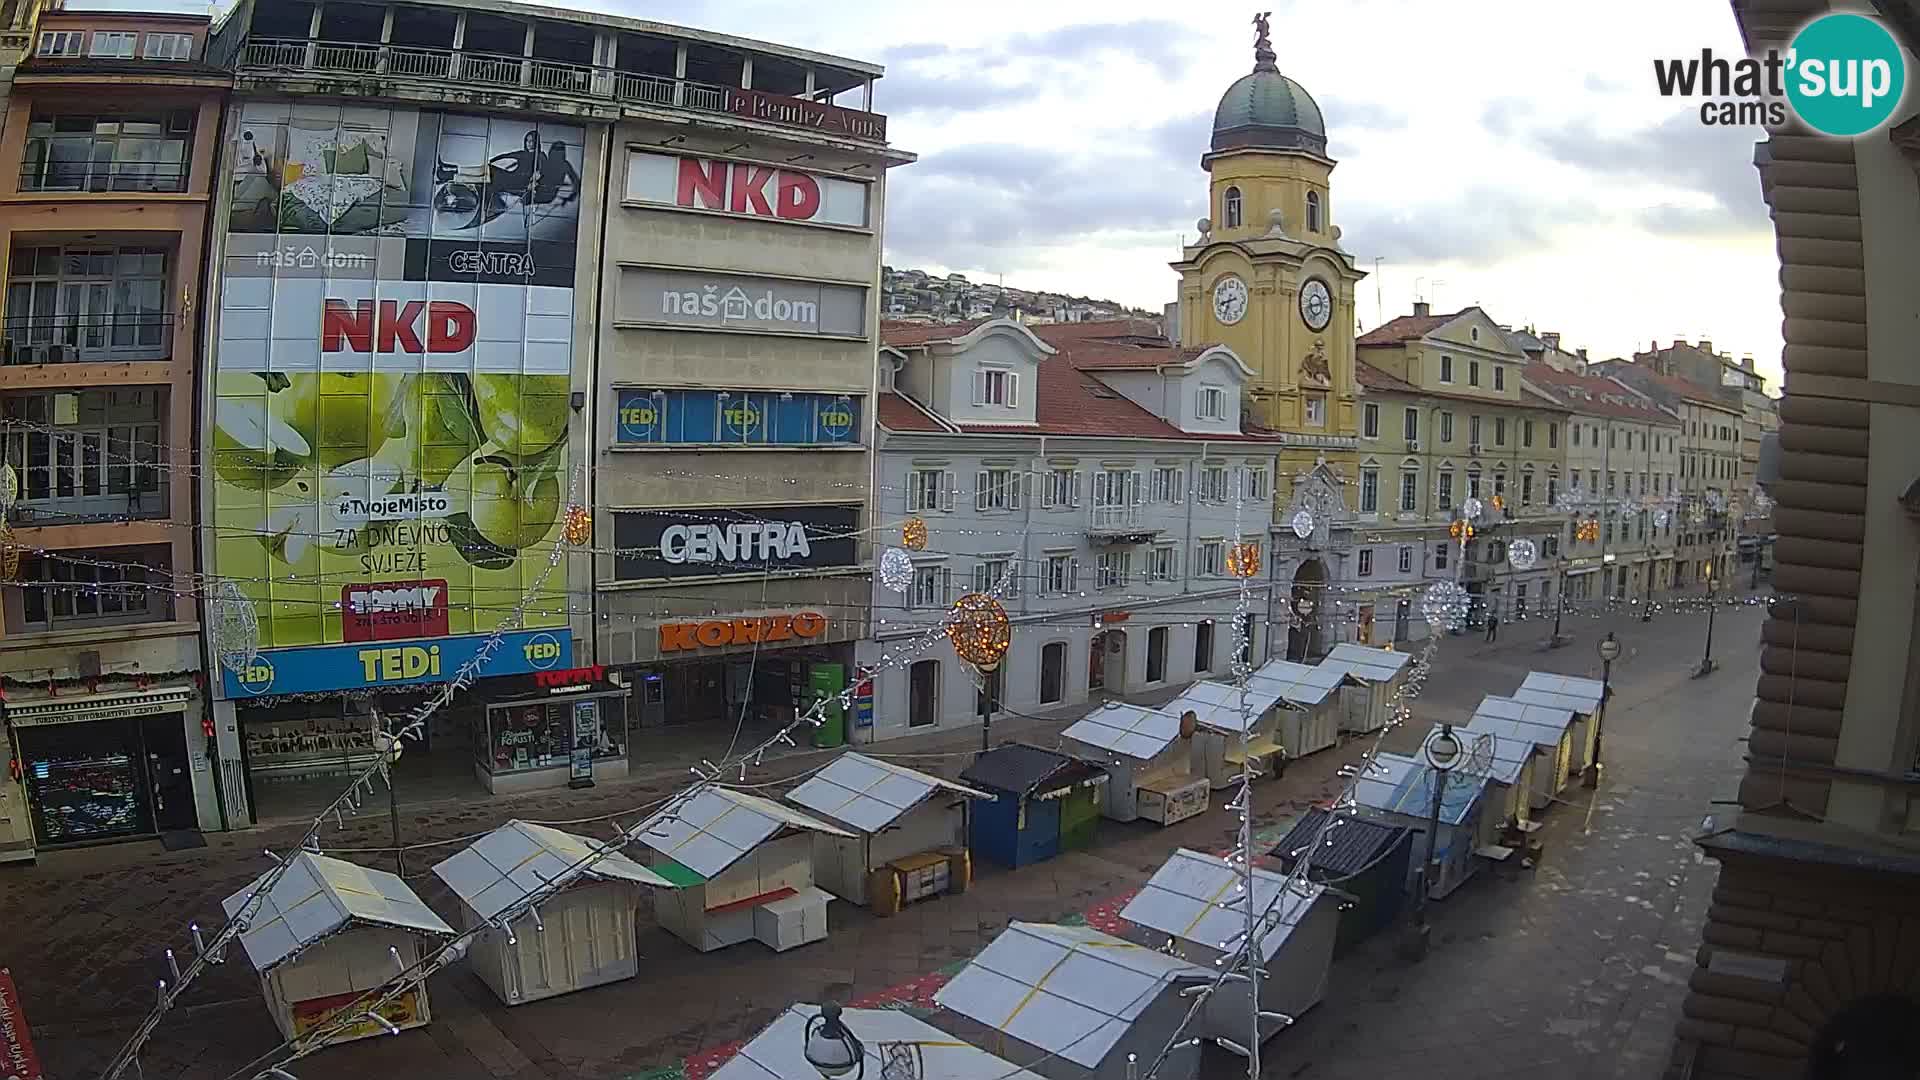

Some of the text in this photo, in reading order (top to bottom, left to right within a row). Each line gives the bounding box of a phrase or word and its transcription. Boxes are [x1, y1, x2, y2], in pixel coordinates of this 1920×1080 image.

[723, 89, 746, 112] Le
[677, 157, 821, 221] NKD
[256, 246, 368, 269] naš dom
[449, 250, 537, 277] CENTRA
[662, 284, 817, 323] naš dom
[321, 297, 478, 354] NKD
[620, 407, 658, 426] TEDi
[723, 409, 760, 426] TEDi
[820, 411, 853, 427] TEDi
[339, 496, 448, 517] #TvojeMisto
[335, 523, 451, 550] ZA DNEVNO
[660, 521, 811, 564] CENTRA
[360, 547, 427, 575] SVJEŽE
[660, 611, 826, 653] KORZO
[358, 645, 441, 682] TEDi
[523, 642, 561, 659] TEDi
[238, 664, 275, 683] TEDi
